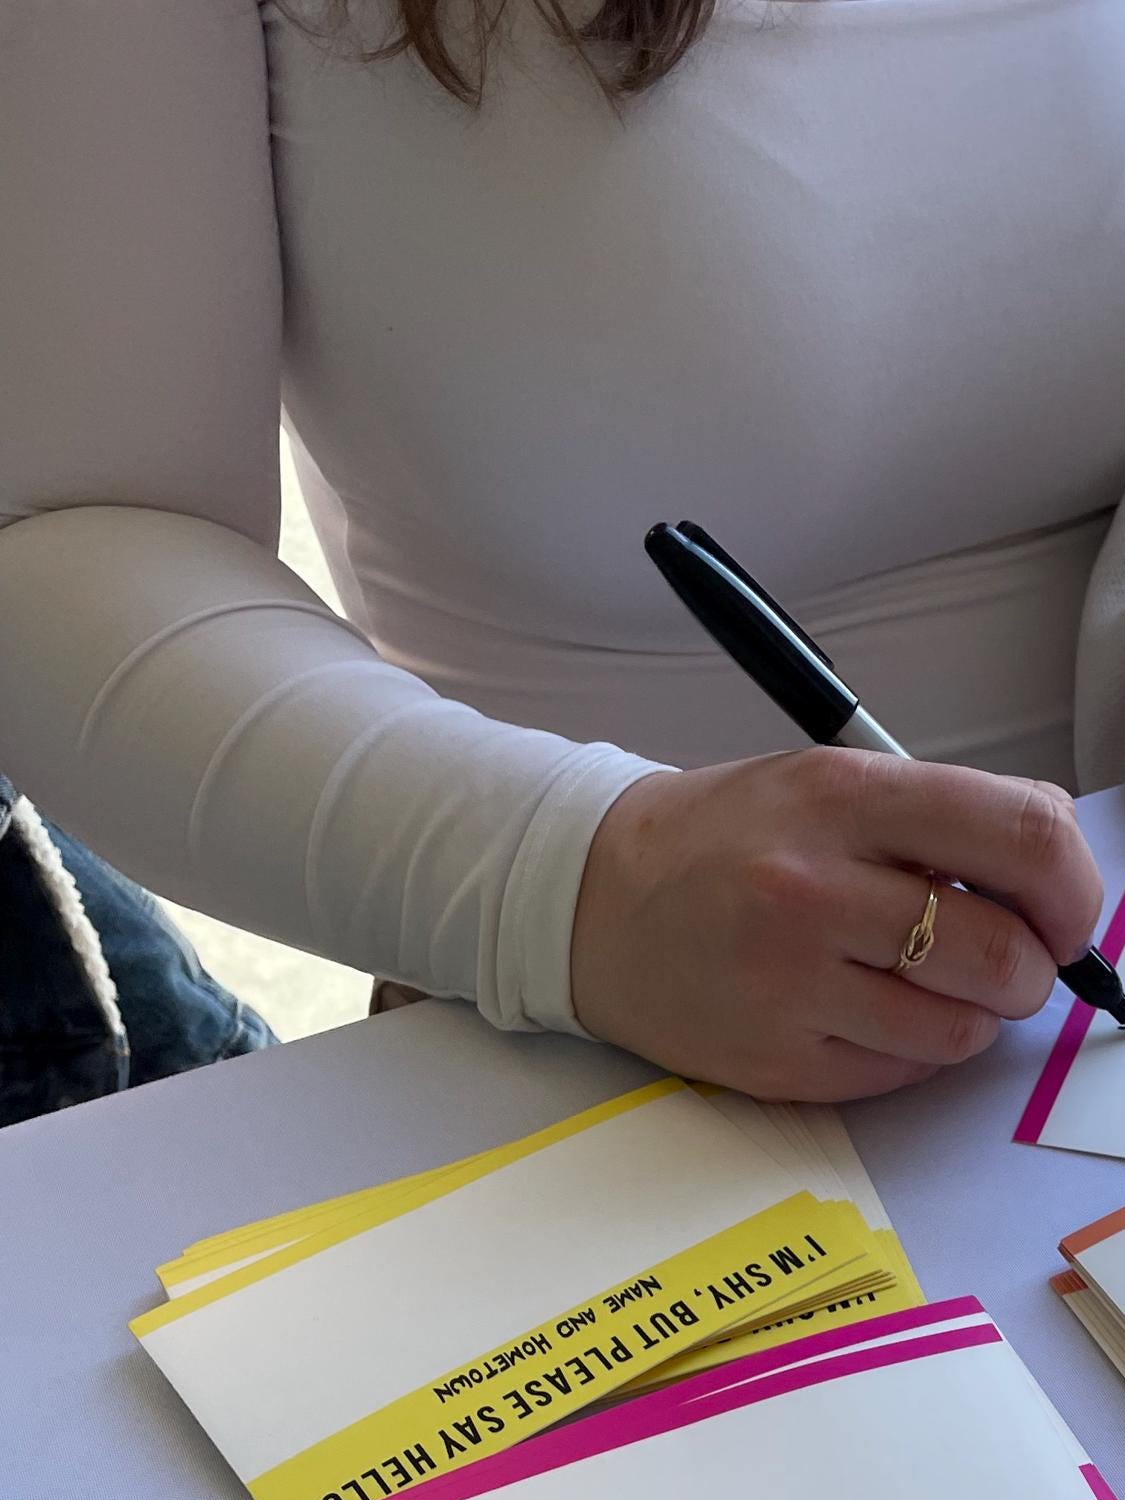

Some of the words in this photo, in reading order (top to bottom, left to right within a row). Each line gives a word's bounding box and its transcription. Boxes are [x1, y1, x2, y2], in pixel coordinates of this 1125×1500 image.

[768, 1234, 828, 1276] I'M
[602, 1275, 663, 1314] NAME
[693, 1263, 773, 1310] SHY,
[559, 1307, 597, 1339] AND
[632, 1300, 700, 1350] BUT
[432, 1332, 554, 1404] HOMETOWN
[502, 1336, 634, 1420] PLEASE
[438, 1405, 505, 1460] SAY
